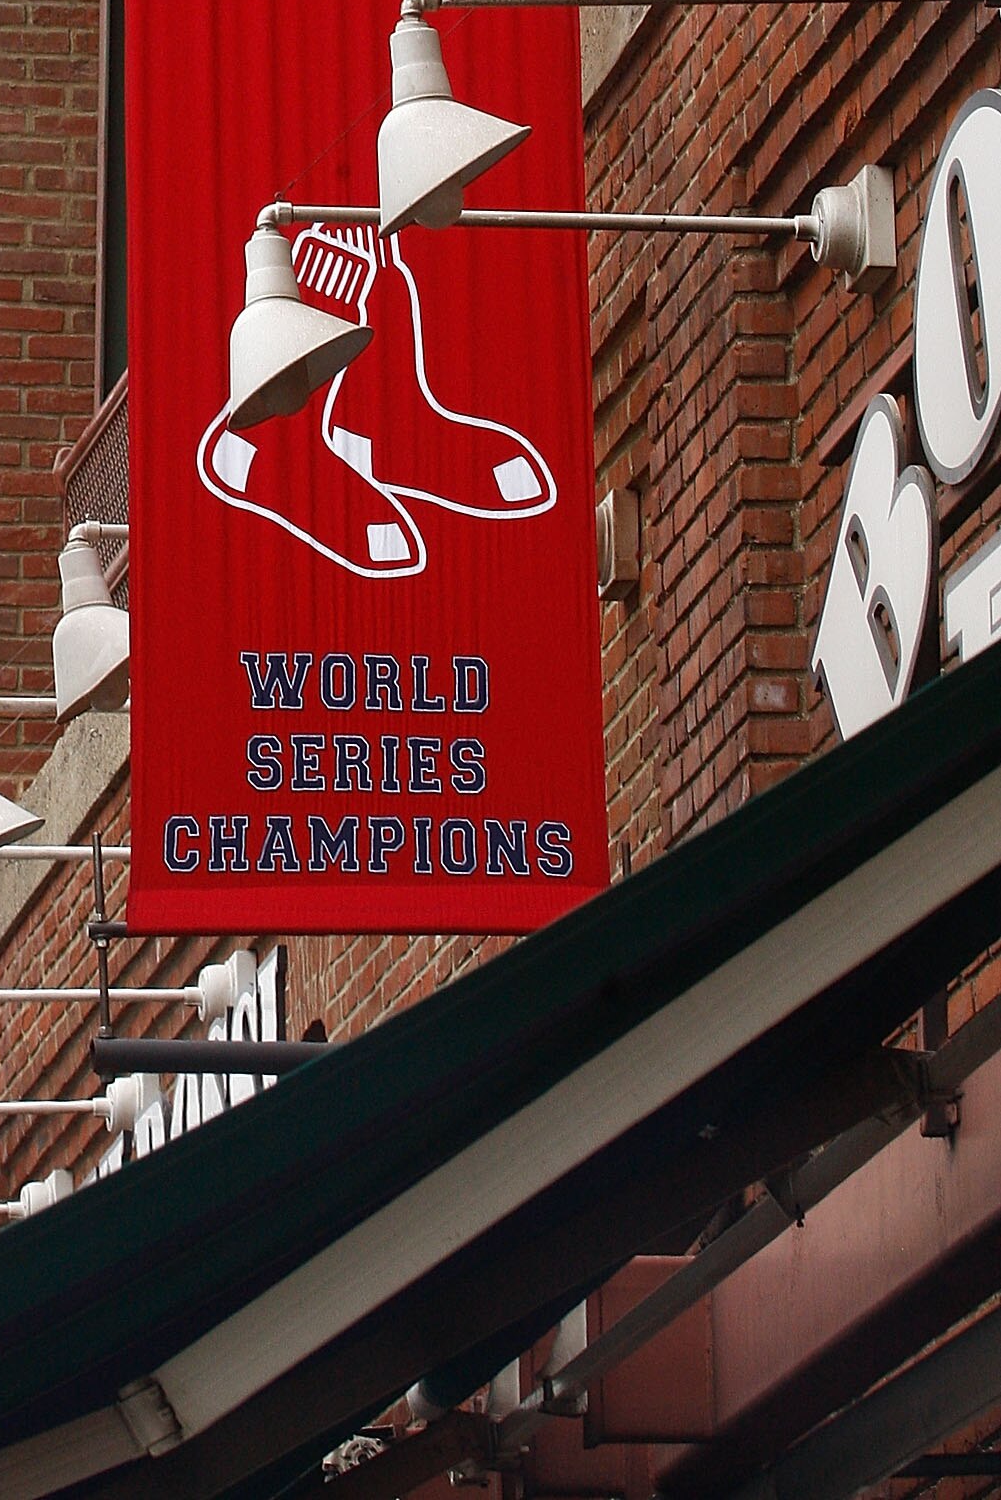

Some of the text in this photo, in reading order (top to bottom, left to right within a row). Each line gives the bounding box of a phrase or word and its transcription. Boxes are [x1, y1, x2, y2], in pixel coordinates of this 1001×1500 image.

[240, 651, 490, 713] WORLD
[246, 734, 486, 794] SERIES
[163, 815, 573, 877] CHAMPIONS
